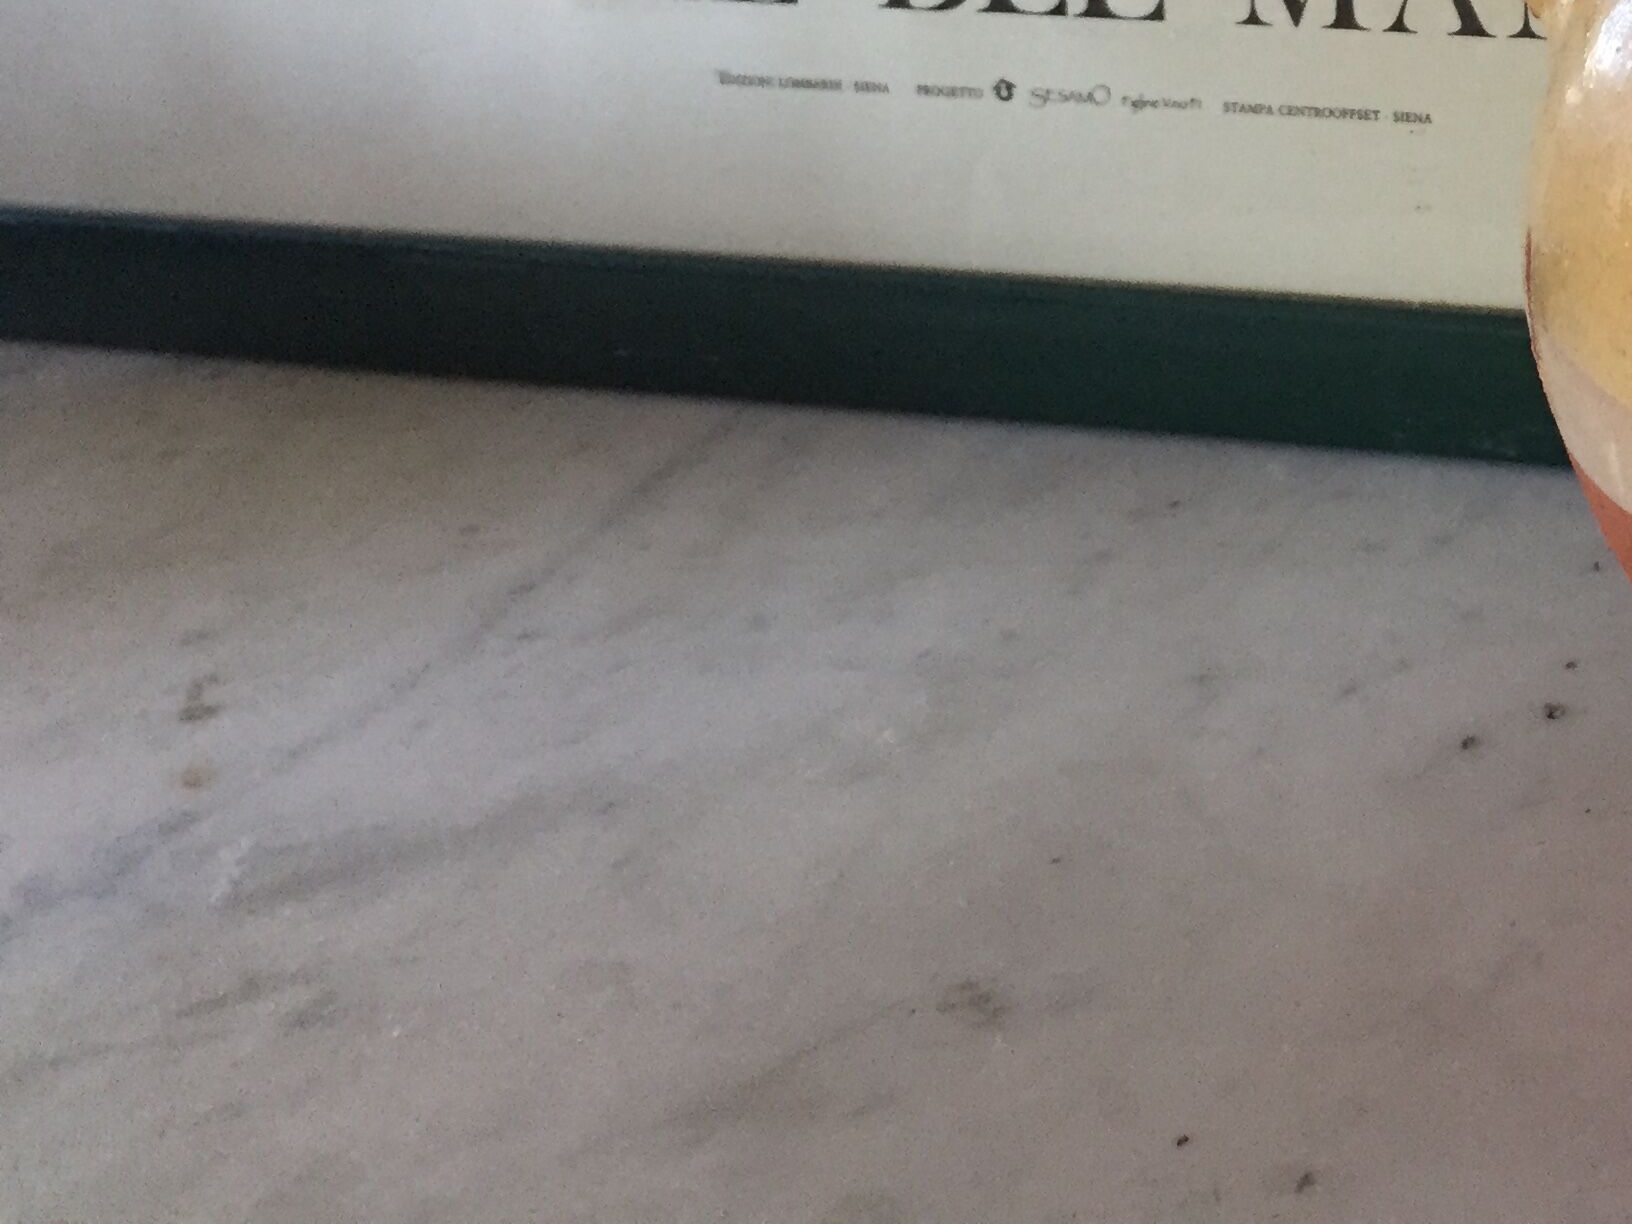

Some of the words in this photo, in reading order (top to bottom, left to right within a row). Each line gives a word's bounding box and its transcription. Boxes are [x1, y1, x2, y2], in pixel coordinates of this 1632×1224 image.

[916, 84, 984, 98] PROGETTO
[1223, 101, 1273, 115] STAMPA
[1278, 104, 1381, 121] CENTROOFFSET
[1393, 110, 1432, 124] SIENA
